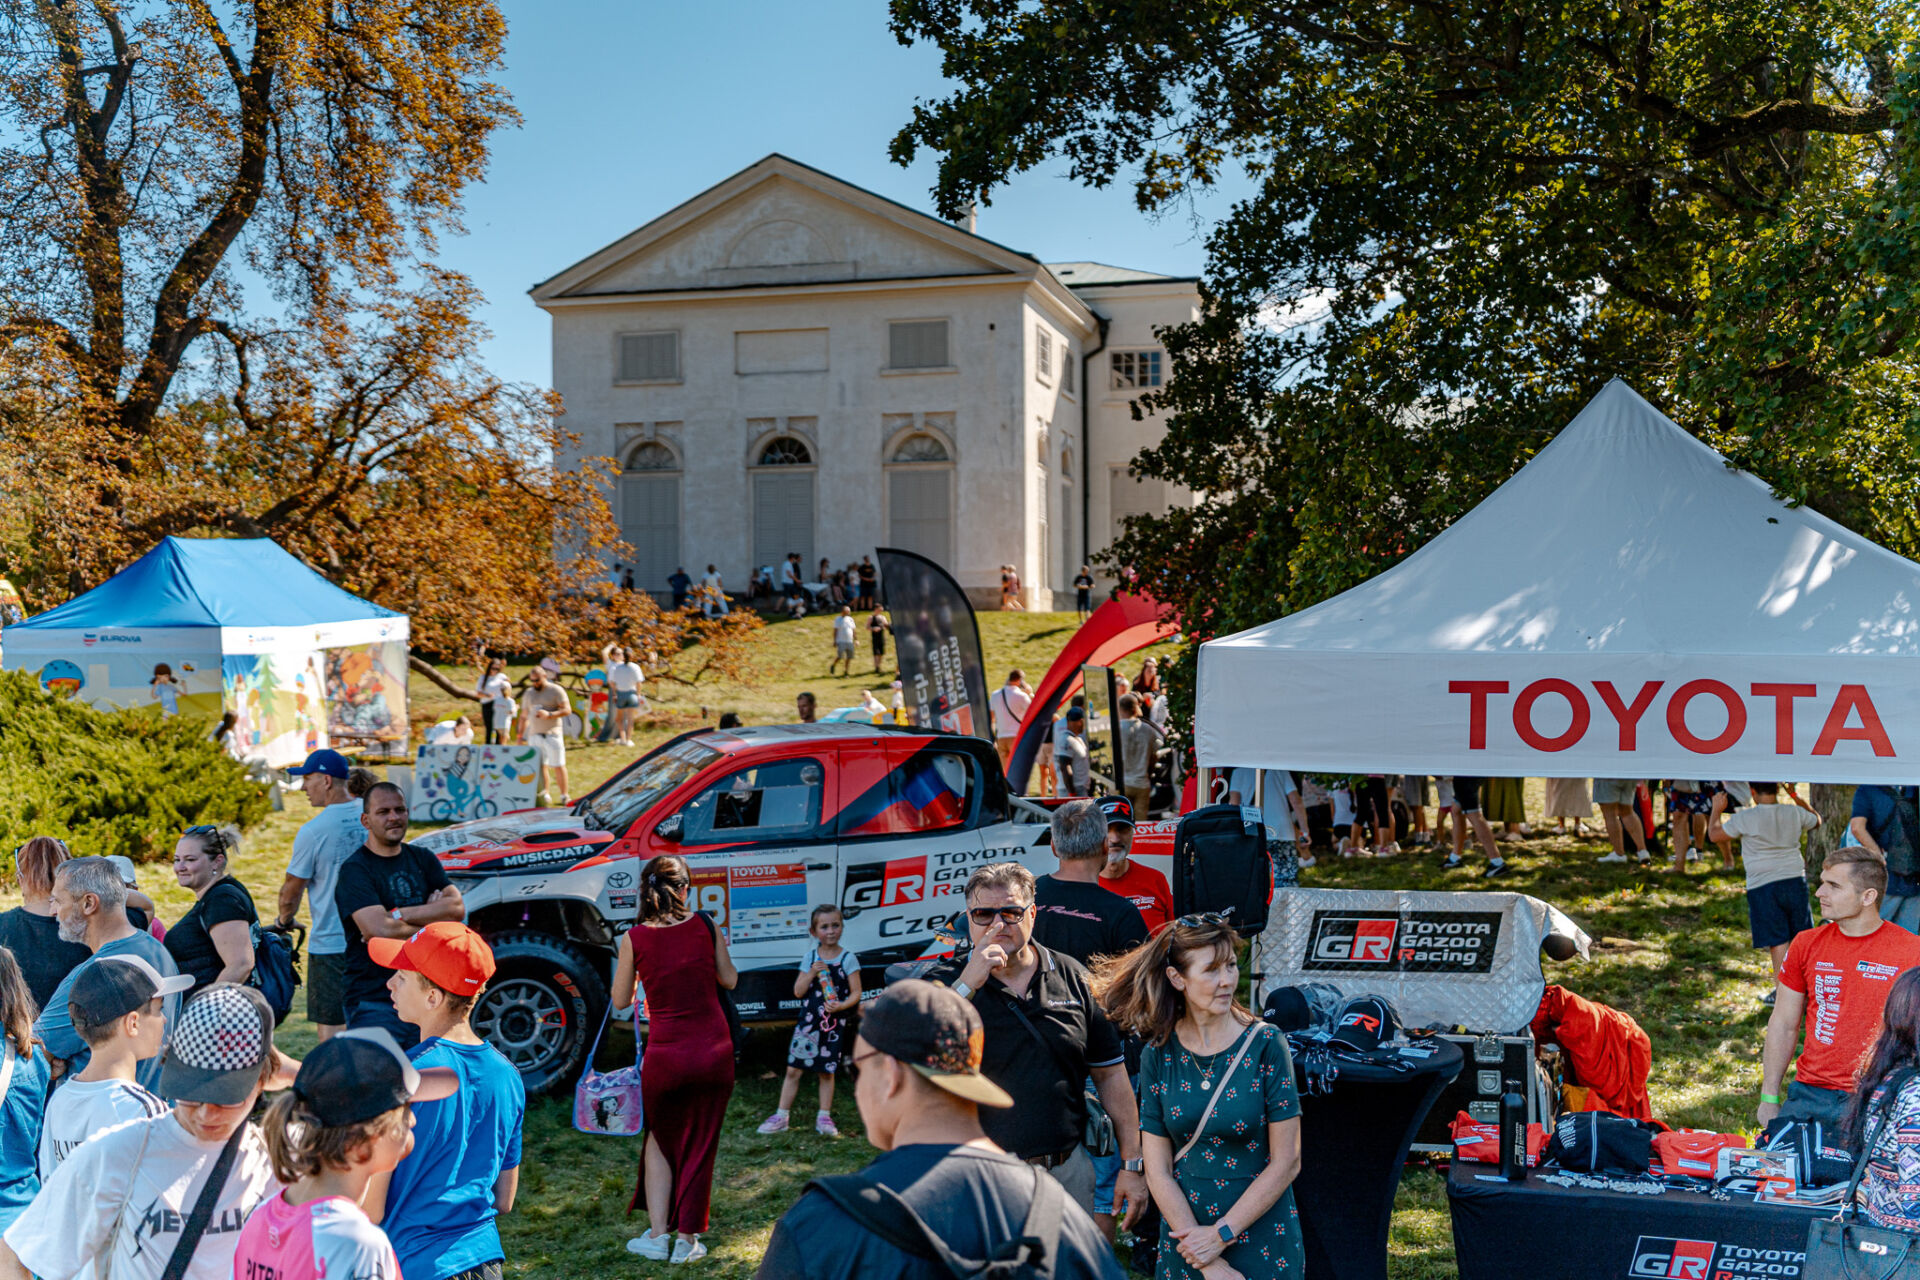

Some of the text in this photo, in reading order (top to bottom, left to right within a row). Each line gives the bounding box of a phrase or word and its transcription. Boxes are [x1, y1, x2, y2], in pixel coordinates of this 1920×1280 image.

[100, 634, 142, 643] EUROVIA
[1448, 678, 1897, 757] TOYOTA
[503, 844, 595, 866] MUSICDATA
[934, 846, 1027, 866] TOYOTA
[732, 865, 778, 877] TOYOTA
[607, 888, 638, 896] TOYOTA
[843, 874, 924, 908] GR
[1402, 921, 1490, 935] TOYOTA
[1316, 935, 1391, 959] GR
[1399, 934, 1481, 948] GAZOO
[1397, 948, 1477, 966] Racing
[1338, 1012, 1380, 1033] GR
[1720, 1244, 1806, 1263] TOYOTA
[1634, 1252, 1708, 1279] GR
[1717, 1258, 1799, 1276] GAZOO
